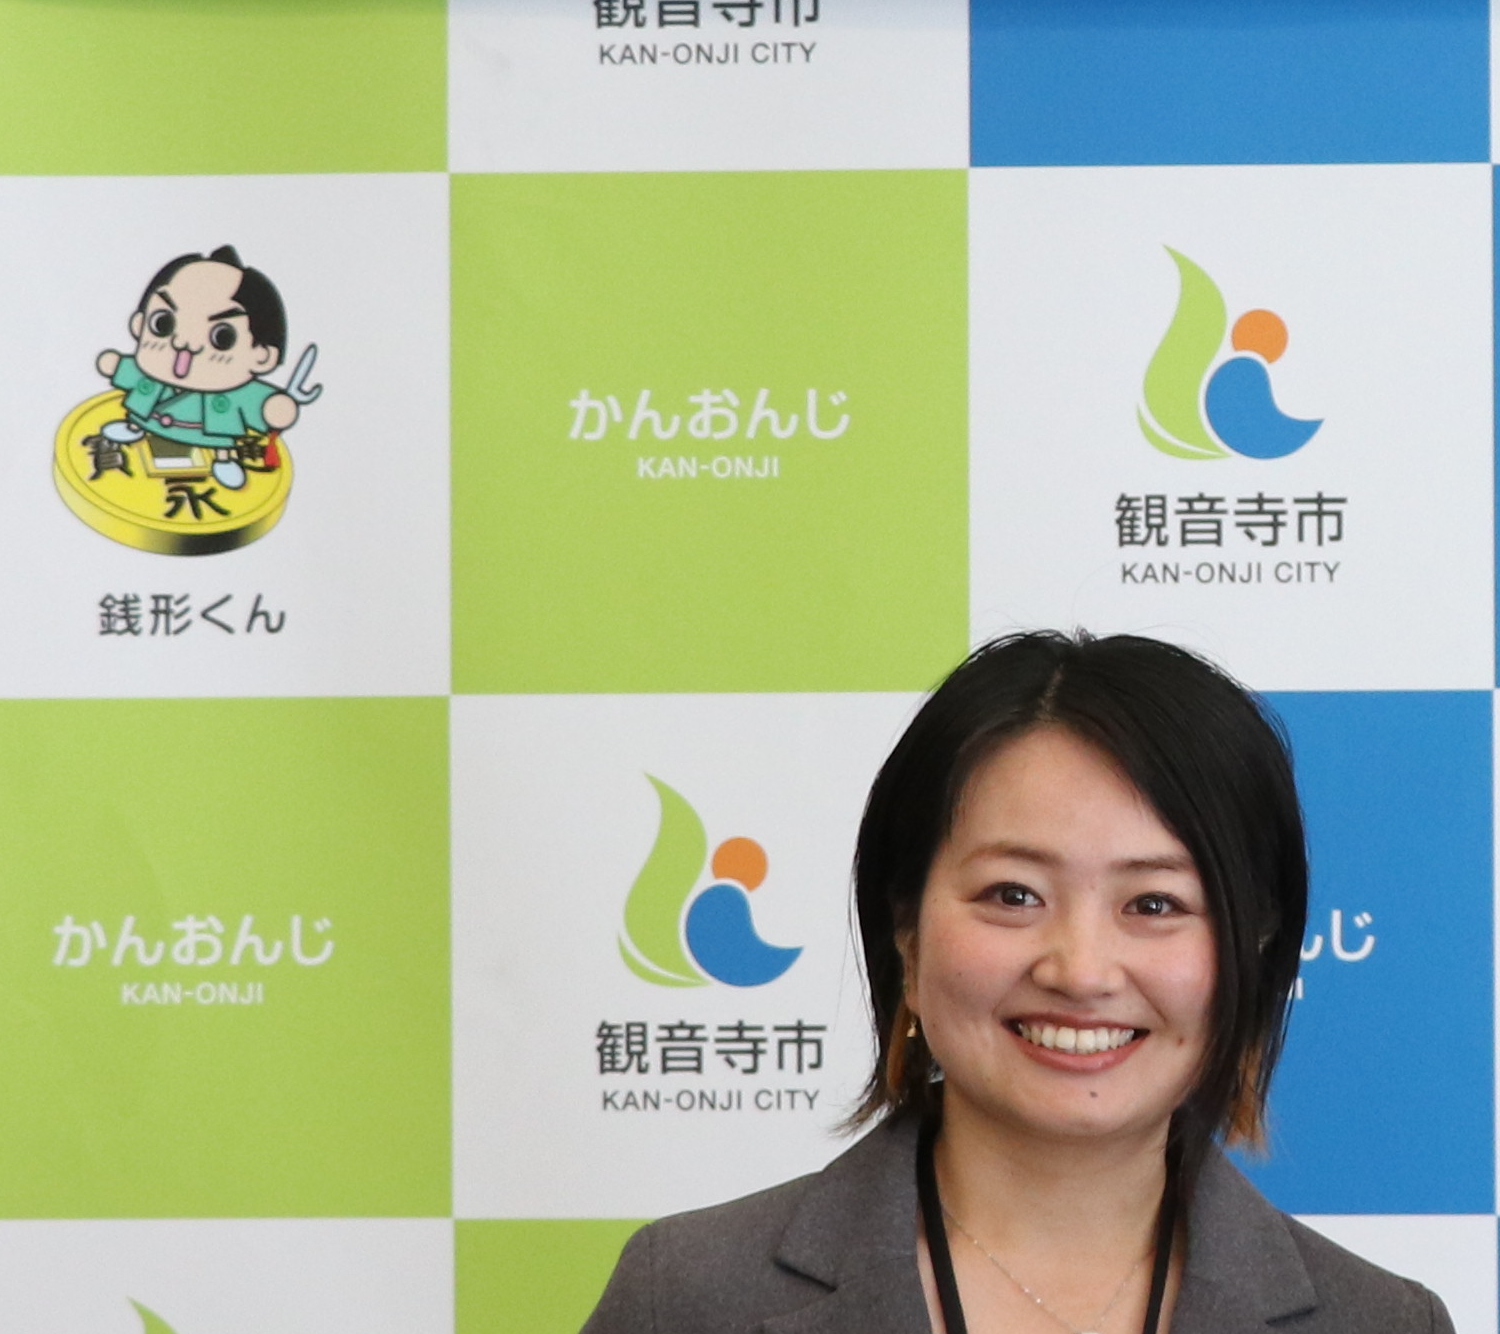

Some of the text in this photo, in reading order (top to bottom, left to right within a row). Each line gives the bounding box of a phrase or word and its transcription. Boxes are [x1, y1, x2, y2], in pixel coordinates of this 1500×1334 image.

[600, 43, 815, 64] KAN-ONJI CITY
[569, 388, 850, 441] かんおんじ
[637, 456, 780, 478] KAN-ONJI
[1115, 492, 1347, 547] 観音寺市
[1122, 562, 1339, 583] KAN-ONJI CITY
[99, 594, 285, 636] 銭形くん
[52, 914, 334, 967] かんおんじ
[121, 982, 263, 1005] KAN-ONJI
[596, 1020, 827, 1075] 観音寺市
[603, 1089, 819, 1111] KAN-ONJI CITY
